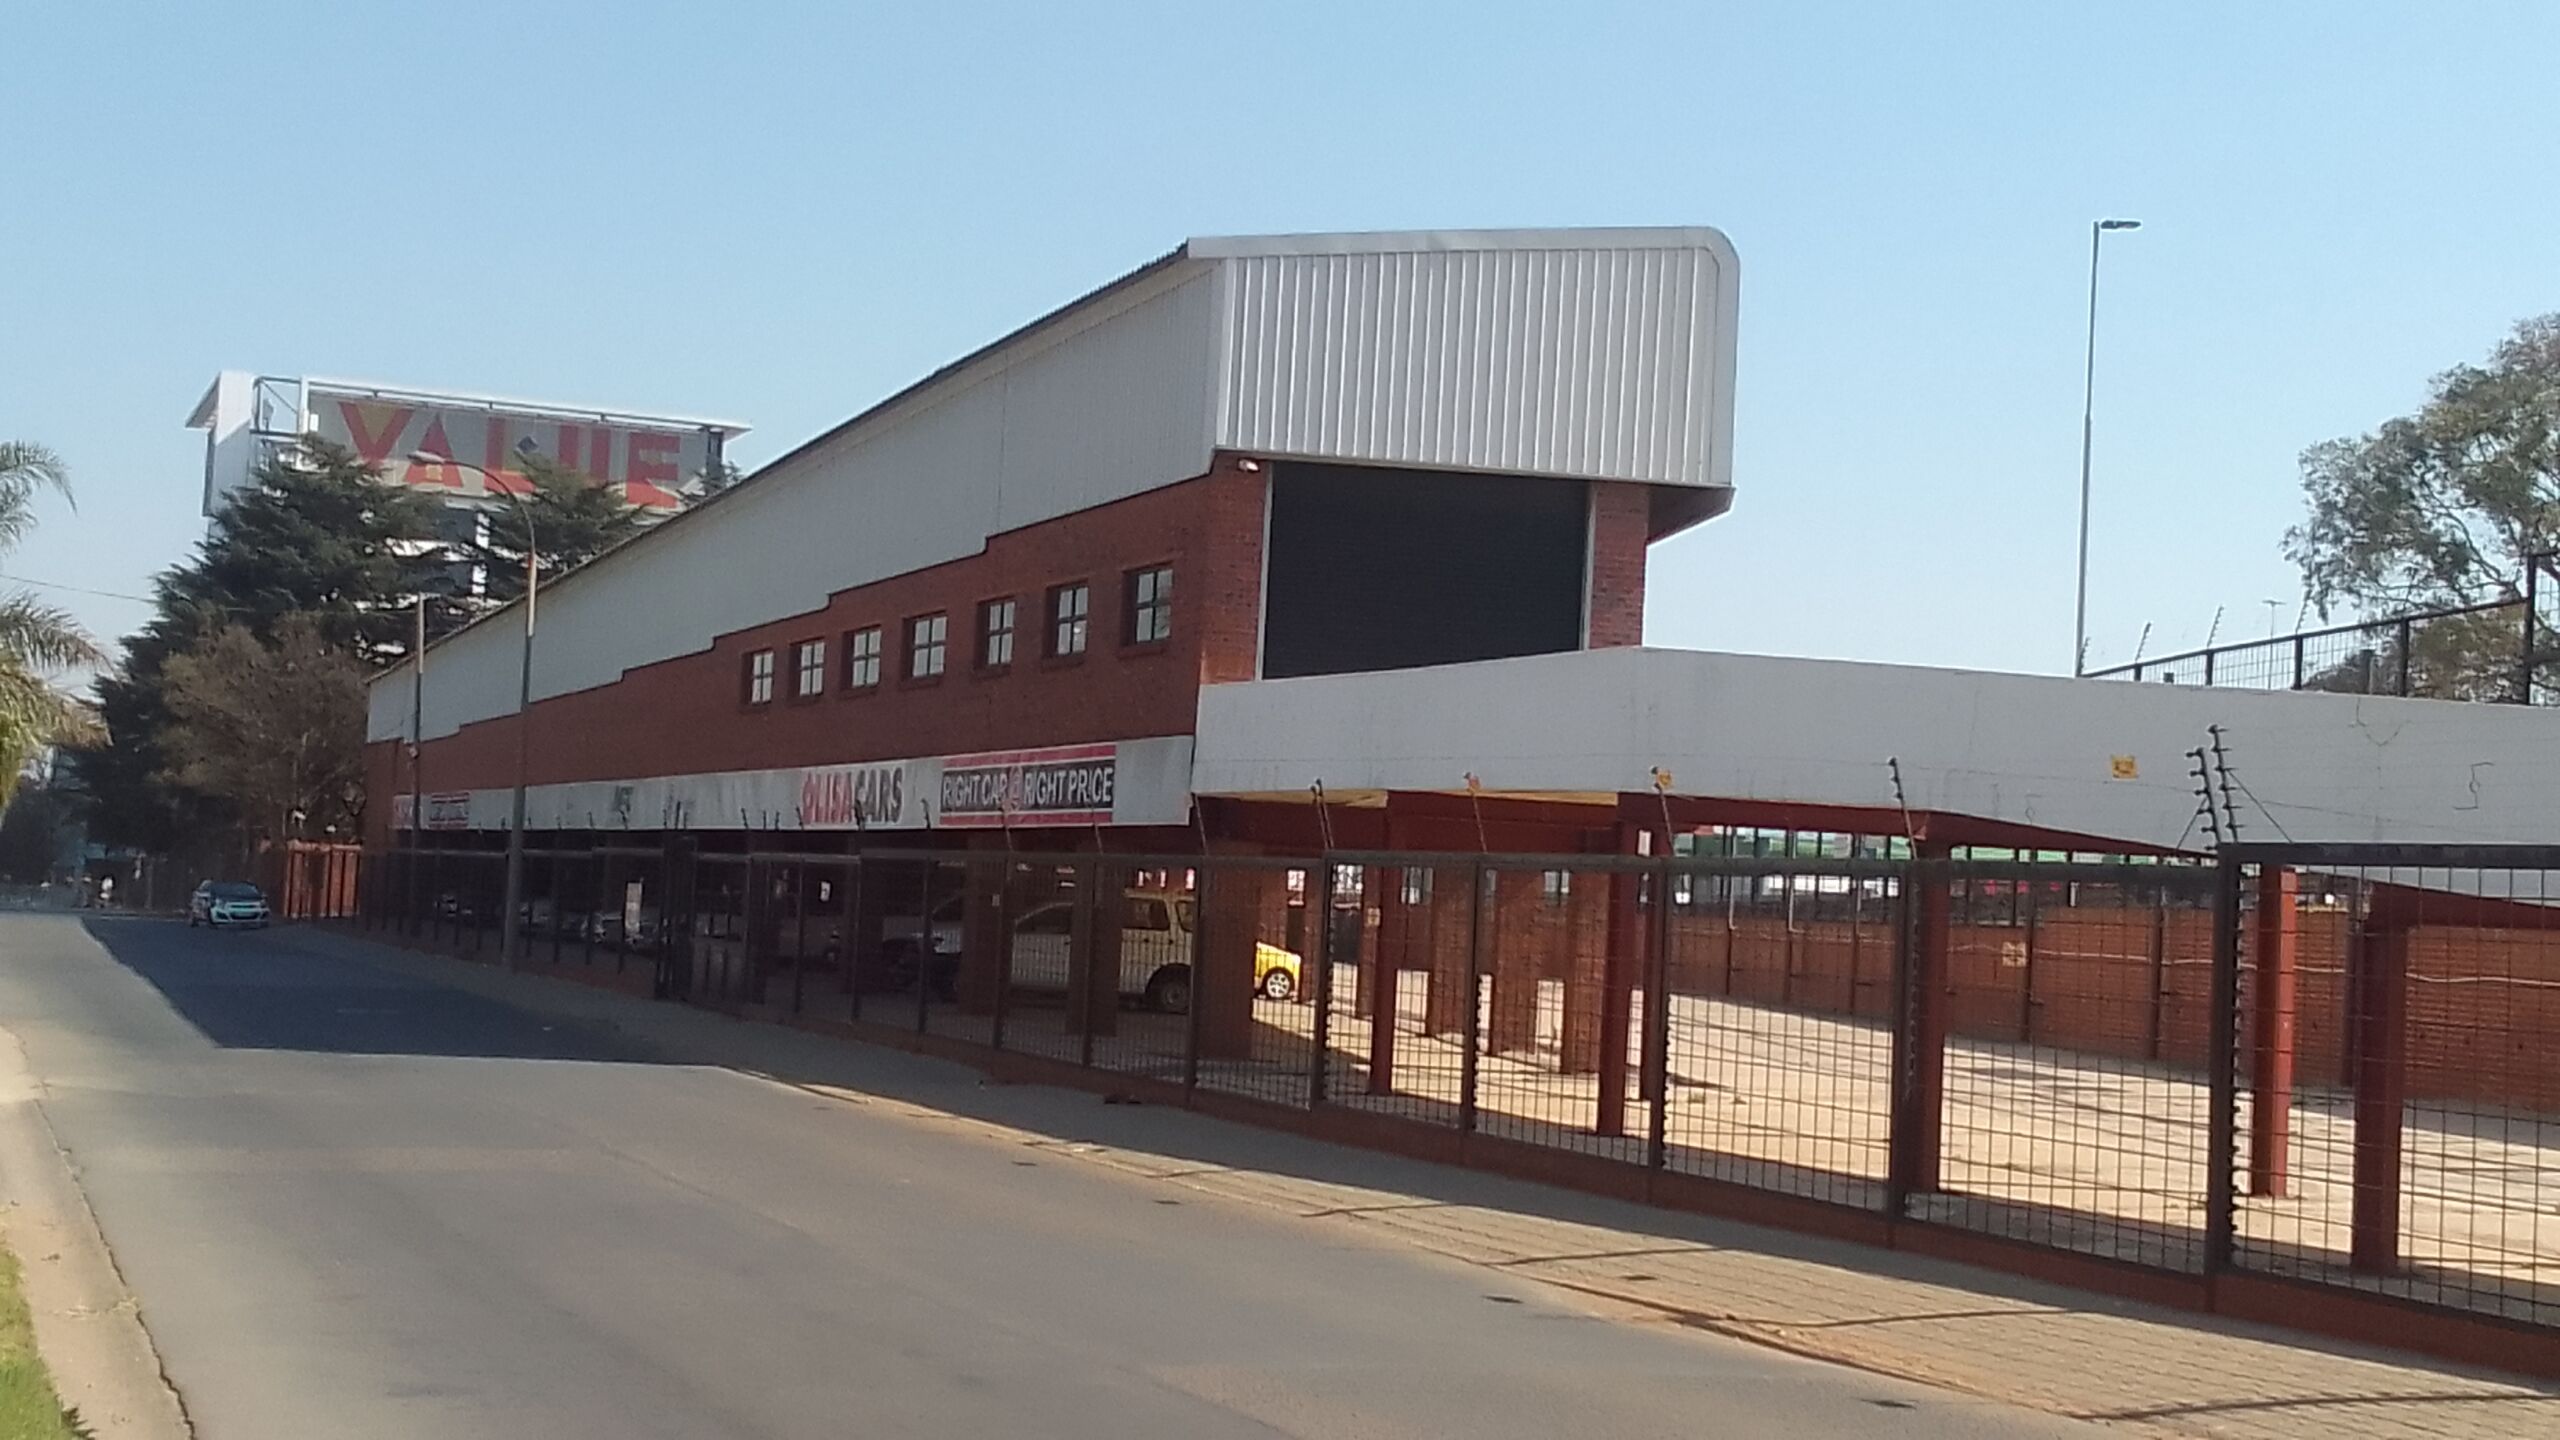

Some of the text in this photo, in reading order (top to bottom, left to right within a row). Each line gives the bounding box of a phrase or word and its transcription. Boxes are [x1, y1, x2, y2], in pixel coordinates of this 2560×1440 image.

[339, 402, 681, 508] VALUE
[858, 767, 903, 822] CARS
[942, 774, 981, 806] RIGHT
[981, 771, 1009, 805] CAR
[1024, 769, 1067, 804] RIGHT
[1067, 767, 1114, 803] PRICE
